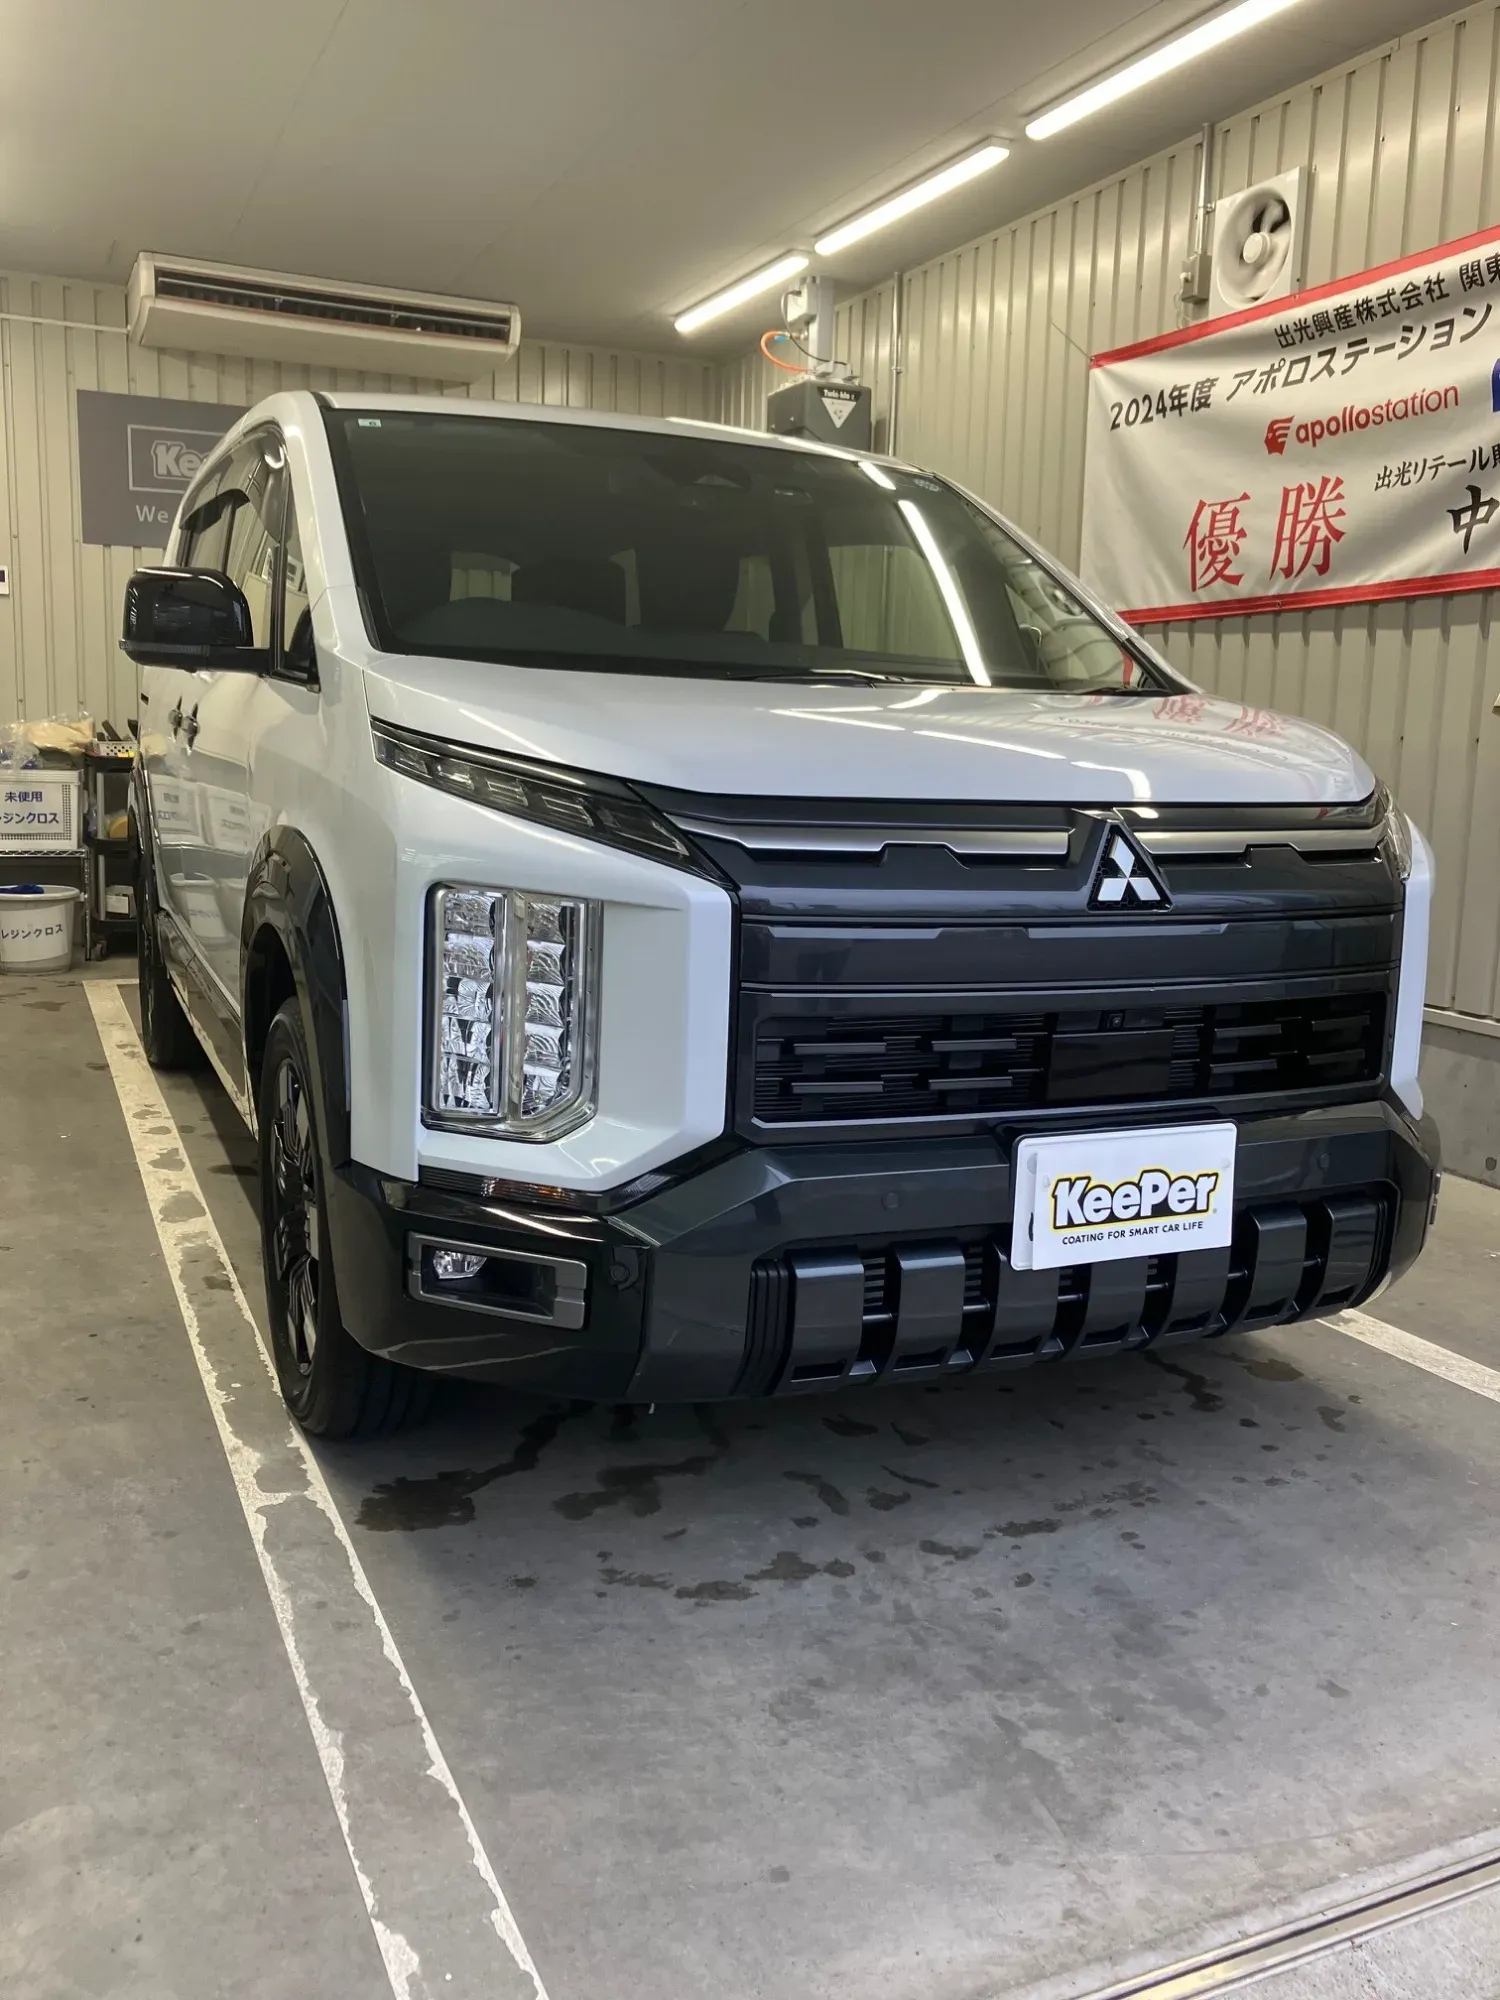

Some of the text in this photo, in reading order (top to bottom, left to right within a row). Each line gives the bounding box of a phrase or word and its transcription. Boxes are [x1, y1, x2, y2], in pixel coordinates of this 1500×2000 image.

[1274, 272, 1450, 349] 出光興産株式会社
[1109, 303, 1493, 432] 2024年度 アポロステーション
[1295, 385, 1459, 447] apollostation
[135, 504, 169, 524] We
[1183, 476, 1347, 592] 優勝
[0, 812, 60, 824] ジンクロス
[4, 791, 43, 803] 未使用
[1, 923, 64, 939] レジンクロス
[1052, 1168, 1219, 1229] KeePer
[1062, 1221, 1204, 1245] COATING FOR SMART CAR LIFE
